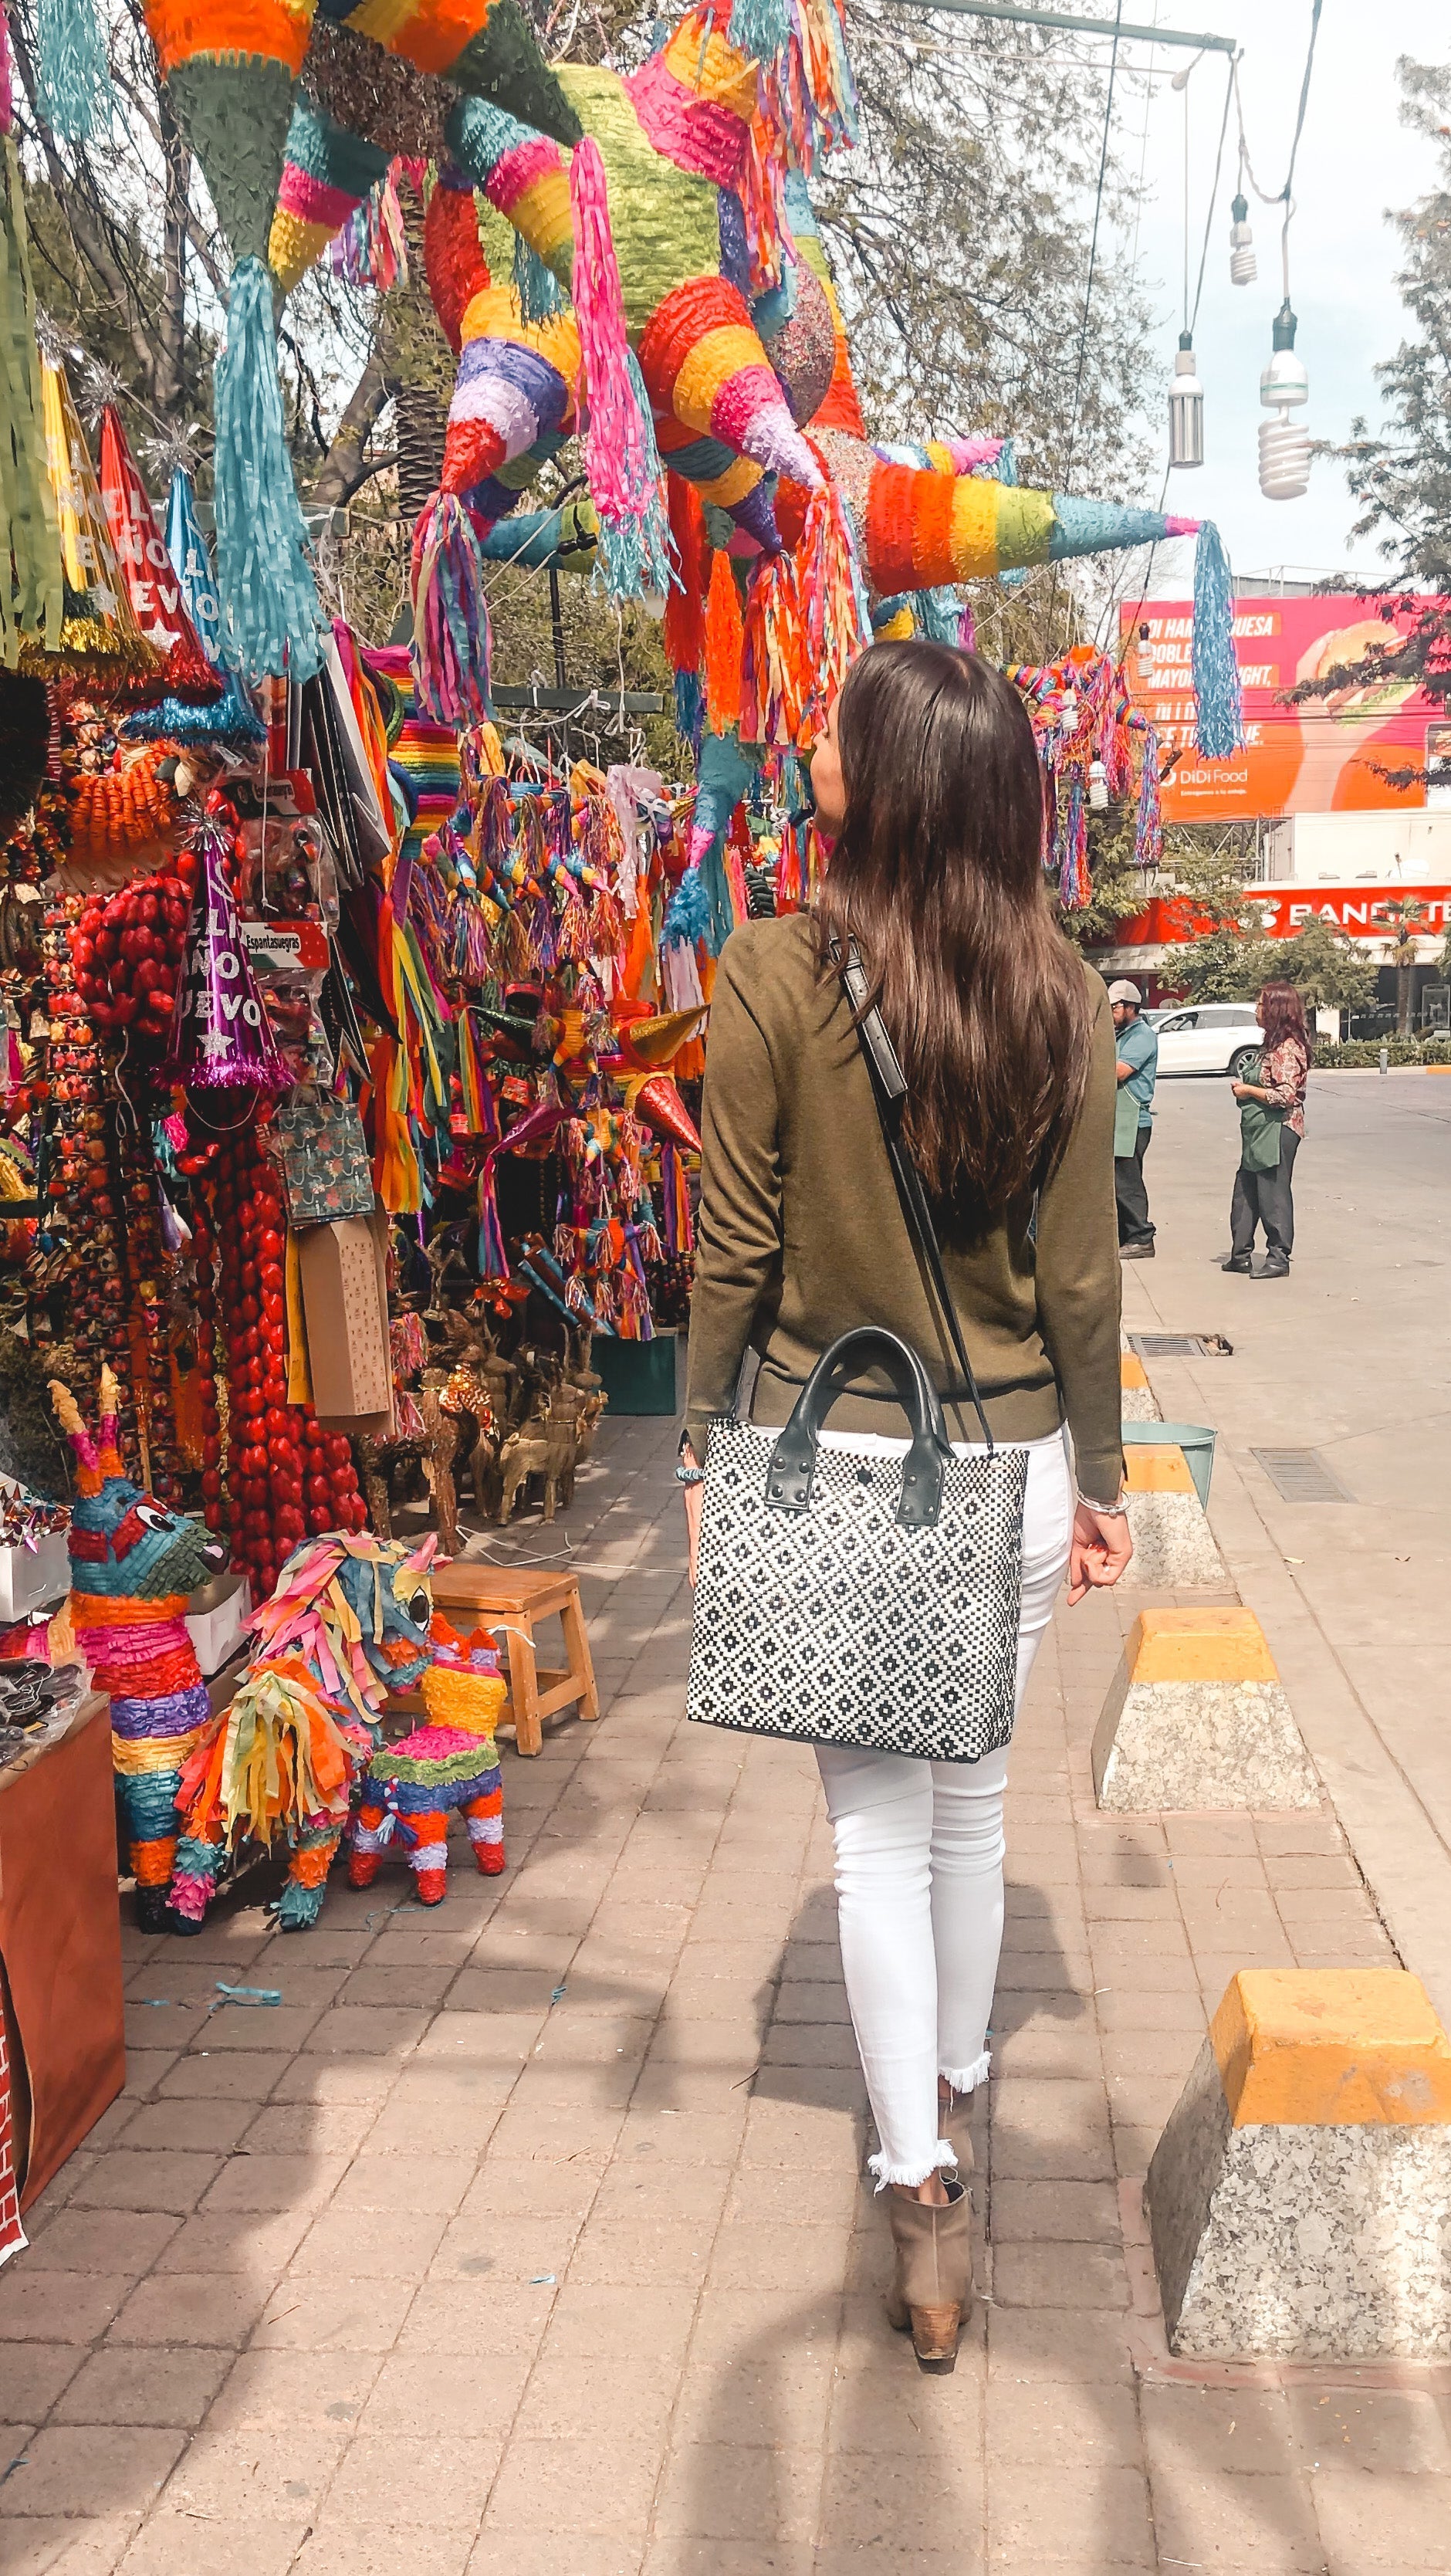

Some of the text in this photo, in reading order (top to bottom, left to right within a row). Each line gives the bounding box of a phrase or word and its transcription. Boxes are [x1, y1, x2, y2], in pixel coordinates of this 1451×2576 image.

[1148, 615, 1273, 639] DI HAMUESA
[1148, 665, 1273, 689] MAYO IGHT,
[1180, 768, 1248, 784] DiDi Food
[246, 934, 300, 953] Espantasuegras
[179, 989, 262, 1027] UEVO
